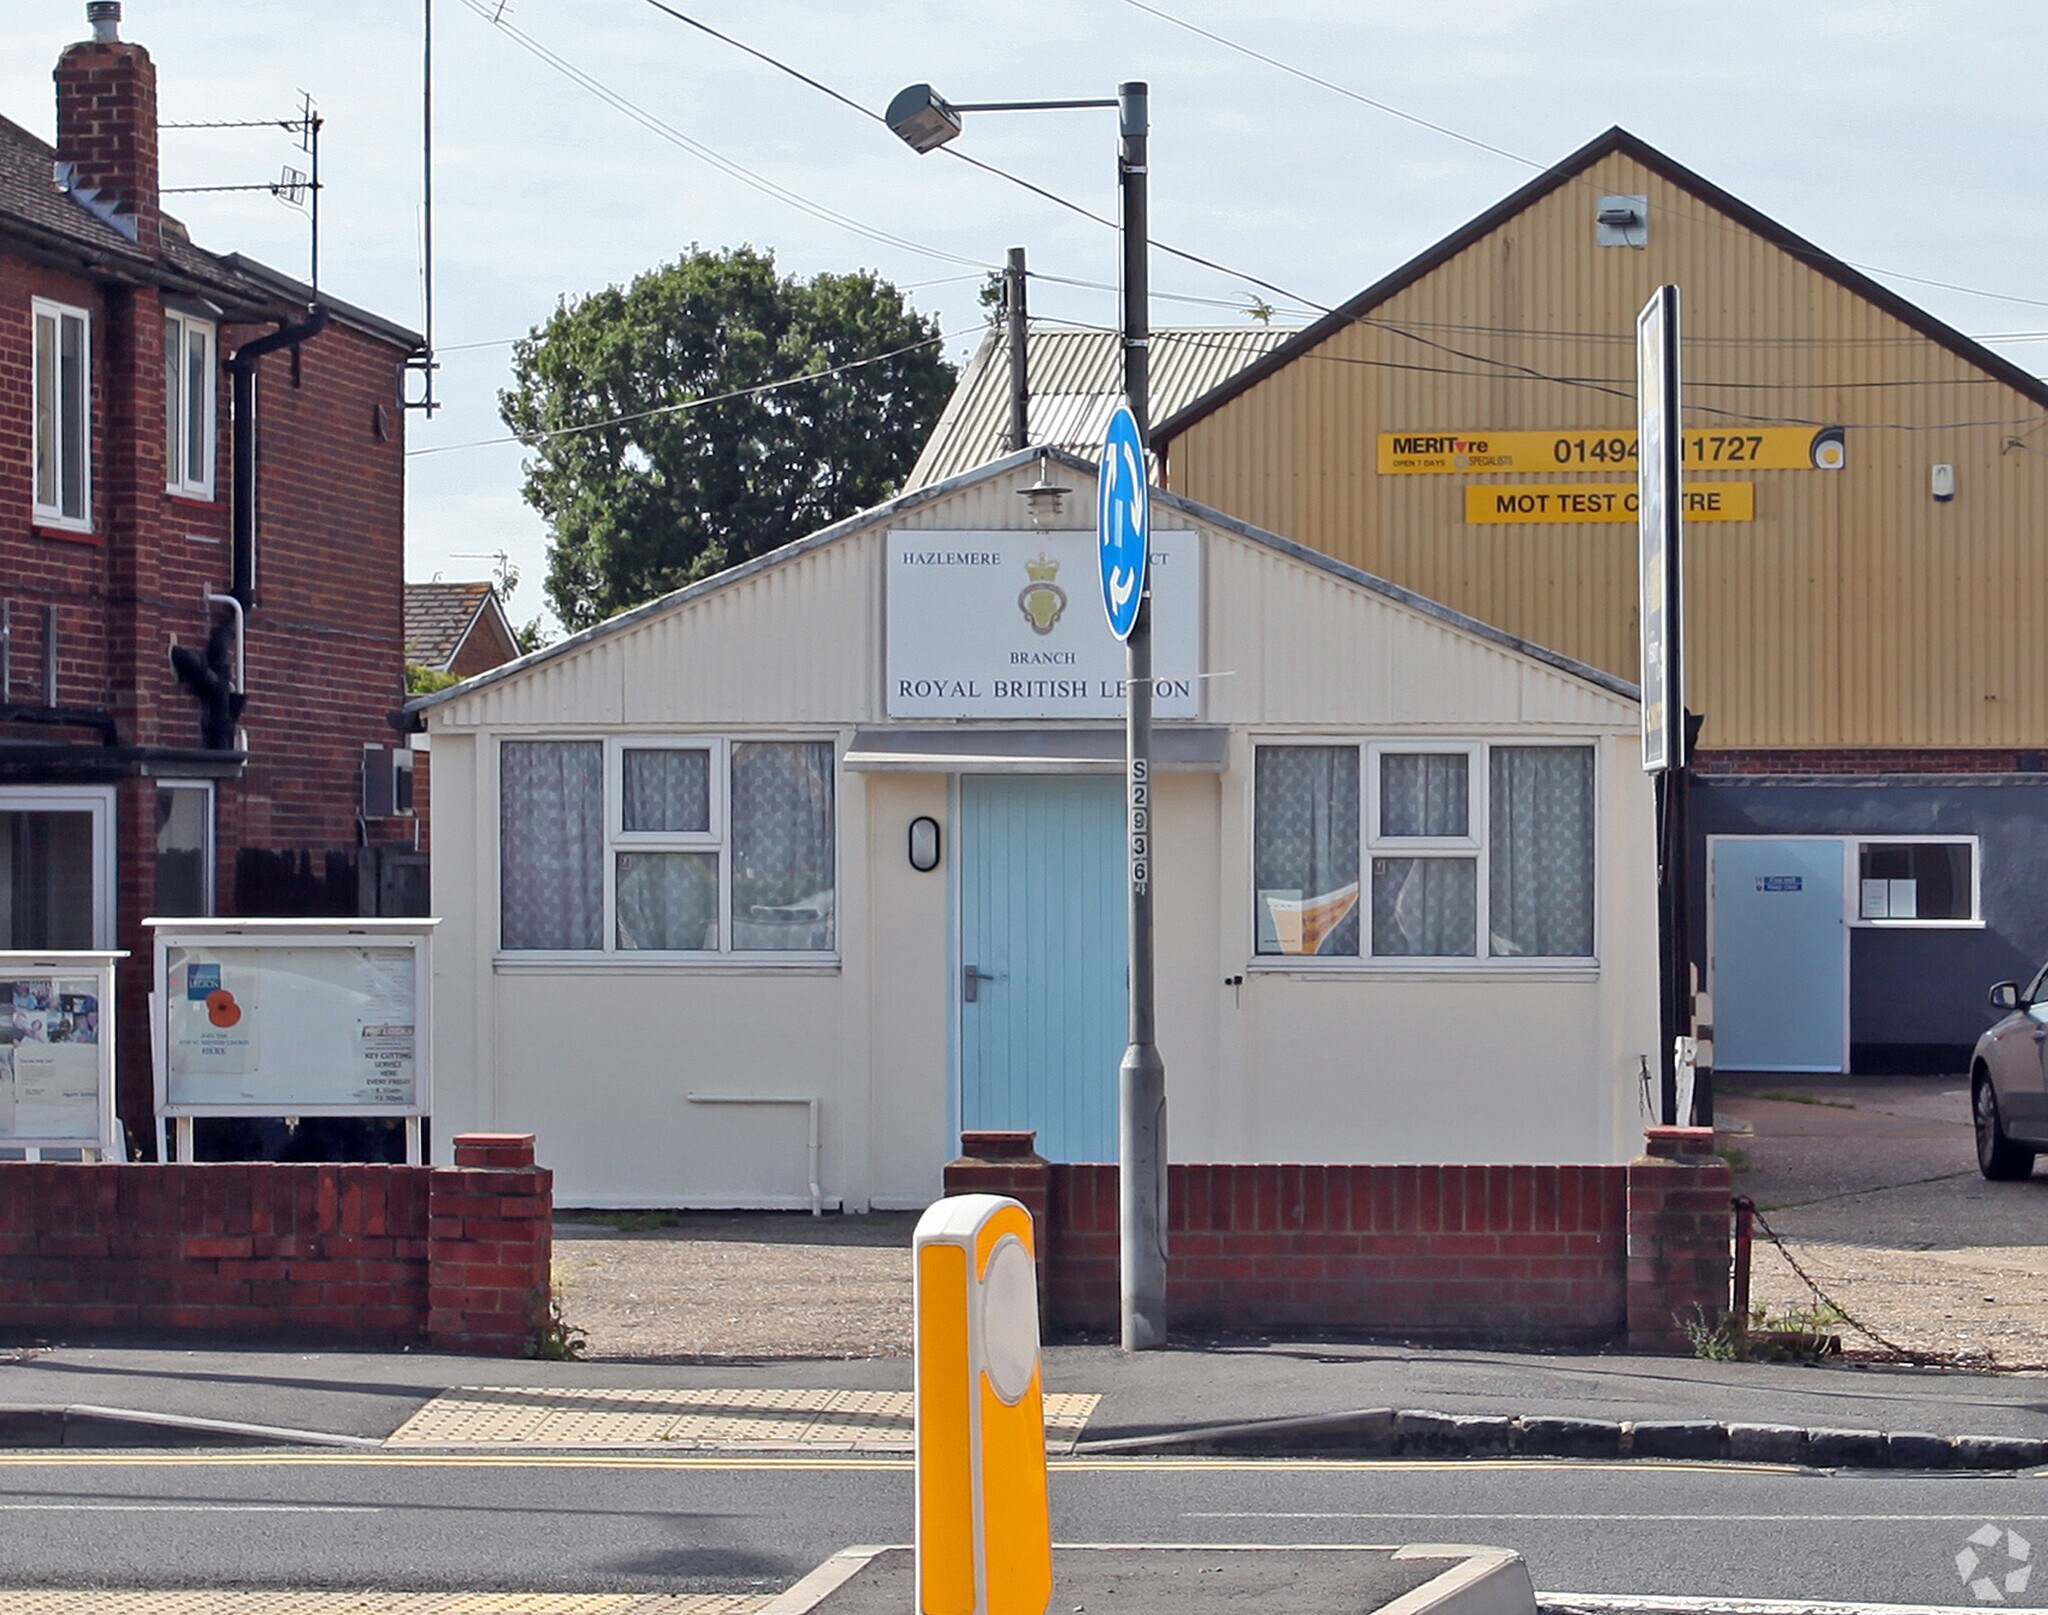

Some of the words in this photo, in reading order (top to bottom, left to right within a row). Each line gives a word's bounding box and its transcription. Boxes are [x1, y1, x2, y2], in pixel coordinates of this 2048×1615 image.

[1423, 459, 1446, 467] DAYS
[1469, 455, 1513, 467] SPECIALISTS
[1496, 495, 1550, 513] MOT
[1557, 494, 1617, 512] TEST
[902, 553, 1001, 565] HAZLEMERE
[1009, 652, 1076, 665] BRANCH
[898, 680, 981, 698] ROYAL
[994, 680, 1087, 698] BRITISH
